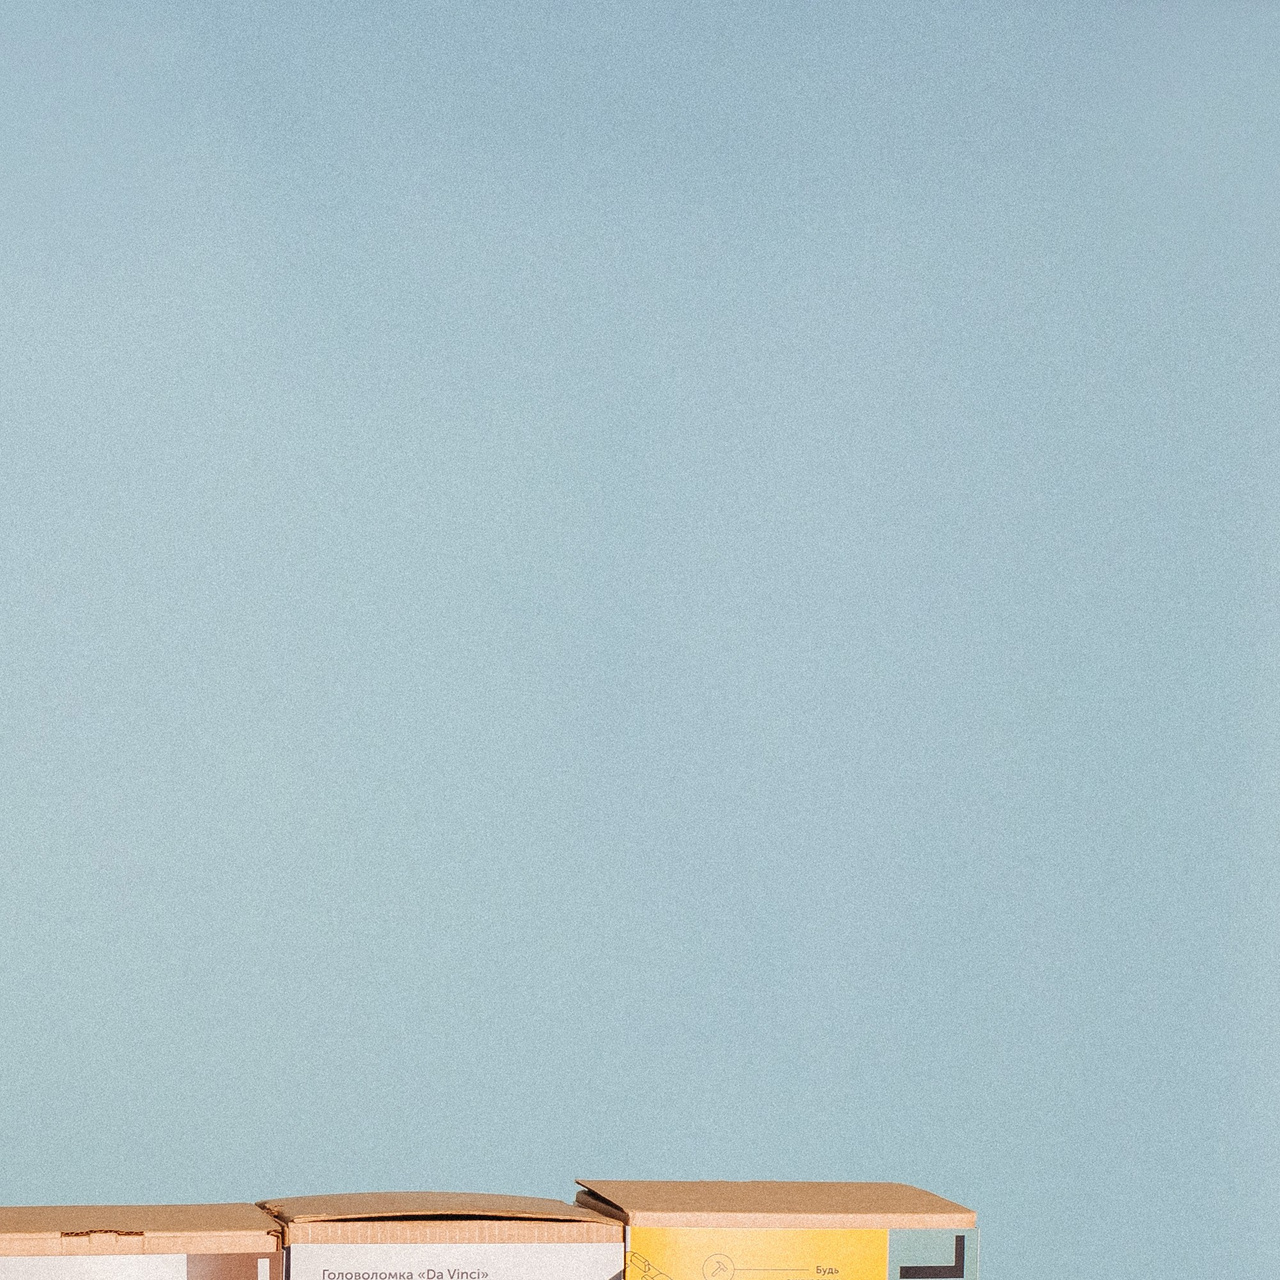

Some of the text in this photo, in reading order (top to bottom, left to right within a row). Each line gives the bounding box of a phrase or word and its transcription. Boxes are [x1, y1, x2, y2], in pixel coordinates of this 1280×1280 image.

[322, 1269, 489, 1280] Головоломка «Da Vinci»
[816, 1265, 839, 1276] Будь
